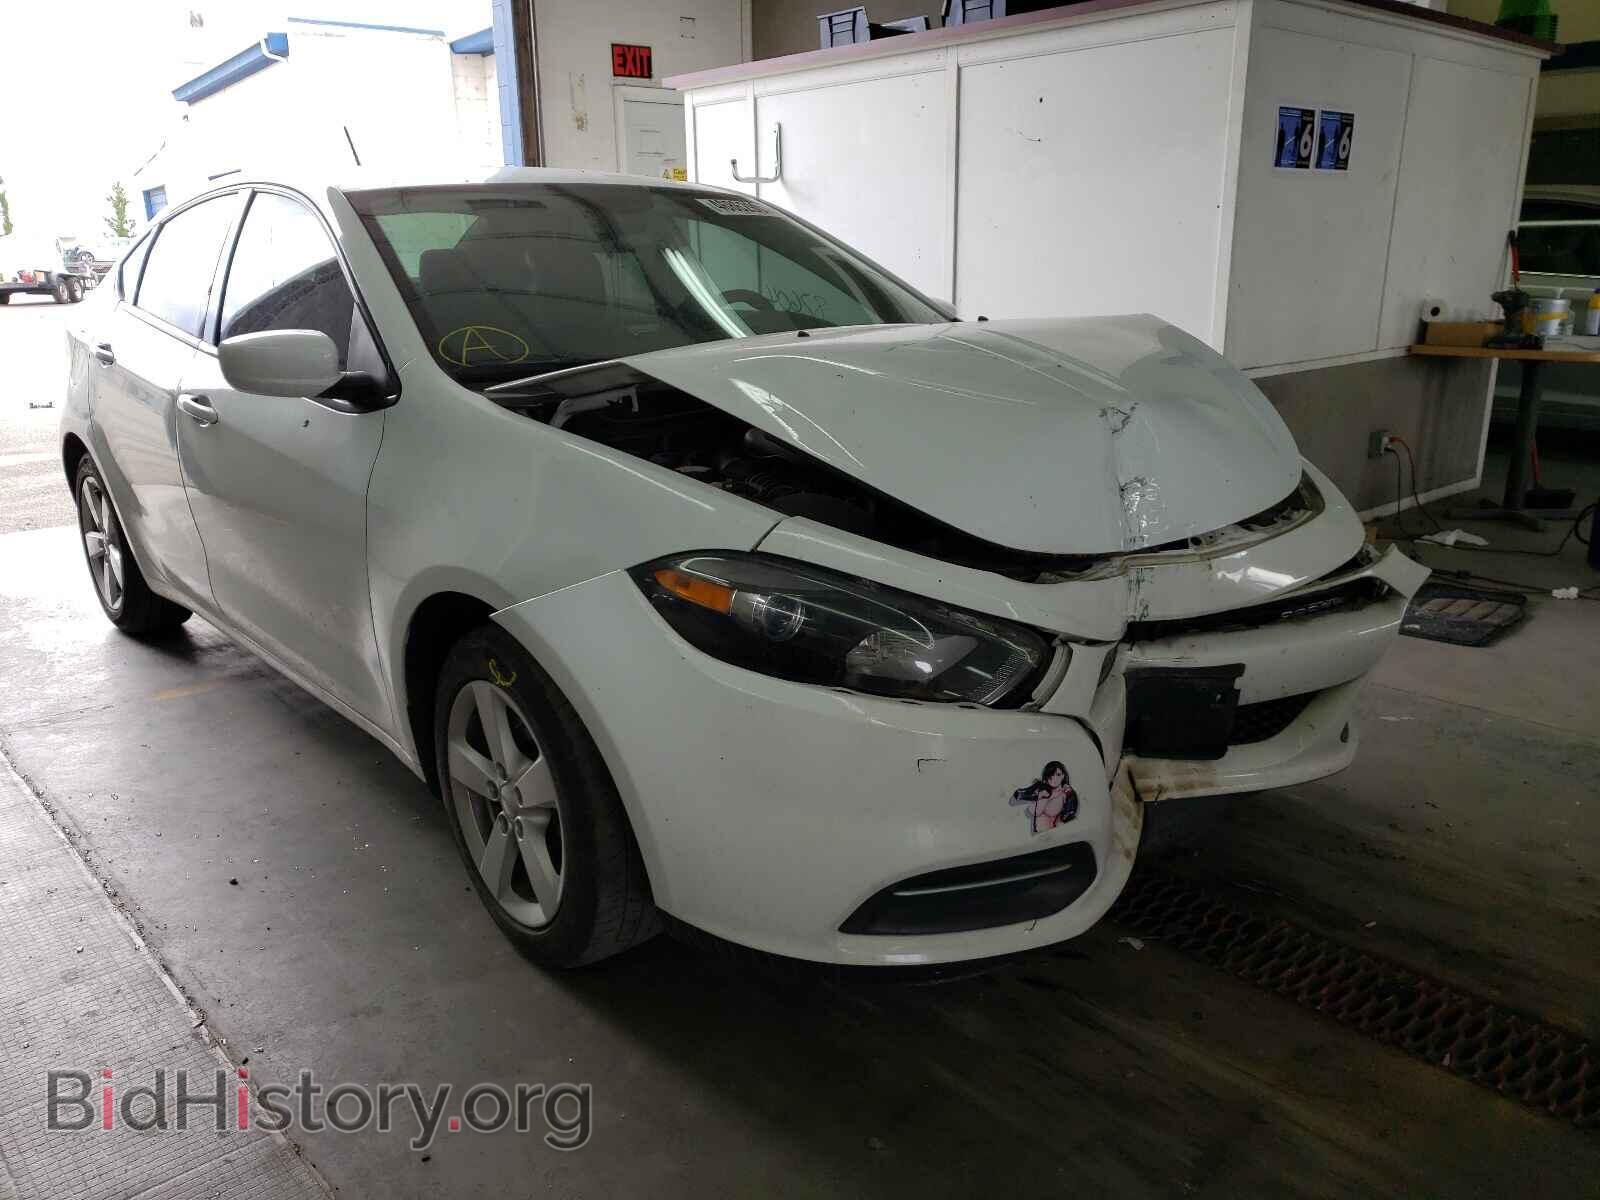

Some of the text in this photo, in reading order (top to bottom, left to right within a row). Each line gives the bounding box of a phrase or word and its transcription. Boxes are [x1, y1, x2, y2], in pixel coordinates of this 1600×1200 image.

[614, 47, 650, 77] EXIT
[1300, 123, 1313, 158] 6
[1339, 126, 1351, 160] 6
[463, 327, 510, 366] A
